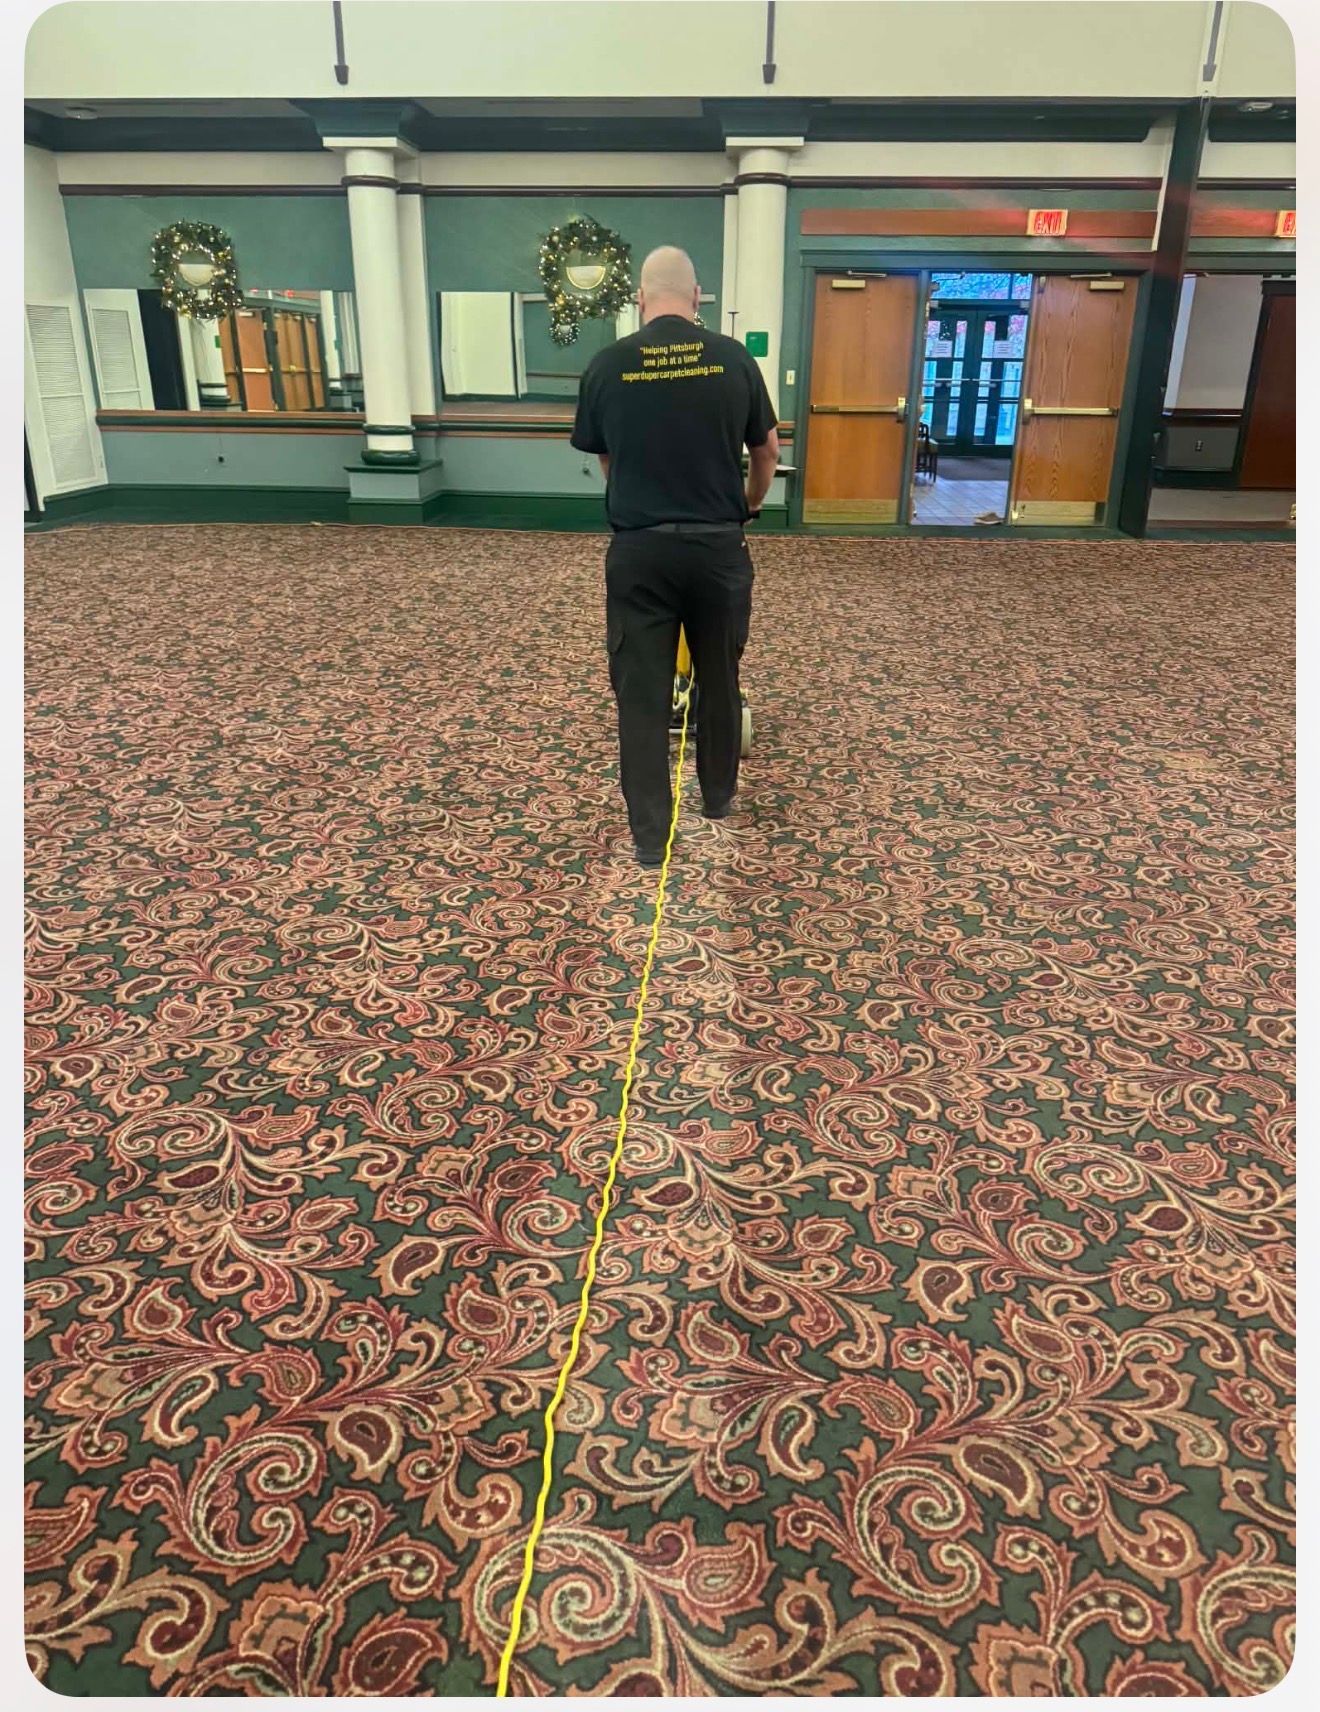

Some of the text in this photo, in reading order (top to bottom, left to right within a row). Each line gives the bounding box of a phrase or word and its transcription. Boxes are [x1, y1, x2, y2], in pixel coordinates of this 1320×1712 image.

[640, 341, 704, 355] "Helping Pittsburgh
[643, 359, 656, 367] one
[657, 356, 668, 368] job
[669, 356, 677, 365] at
[622, 365, 724, 382] superdupercarpetcleaning.com
